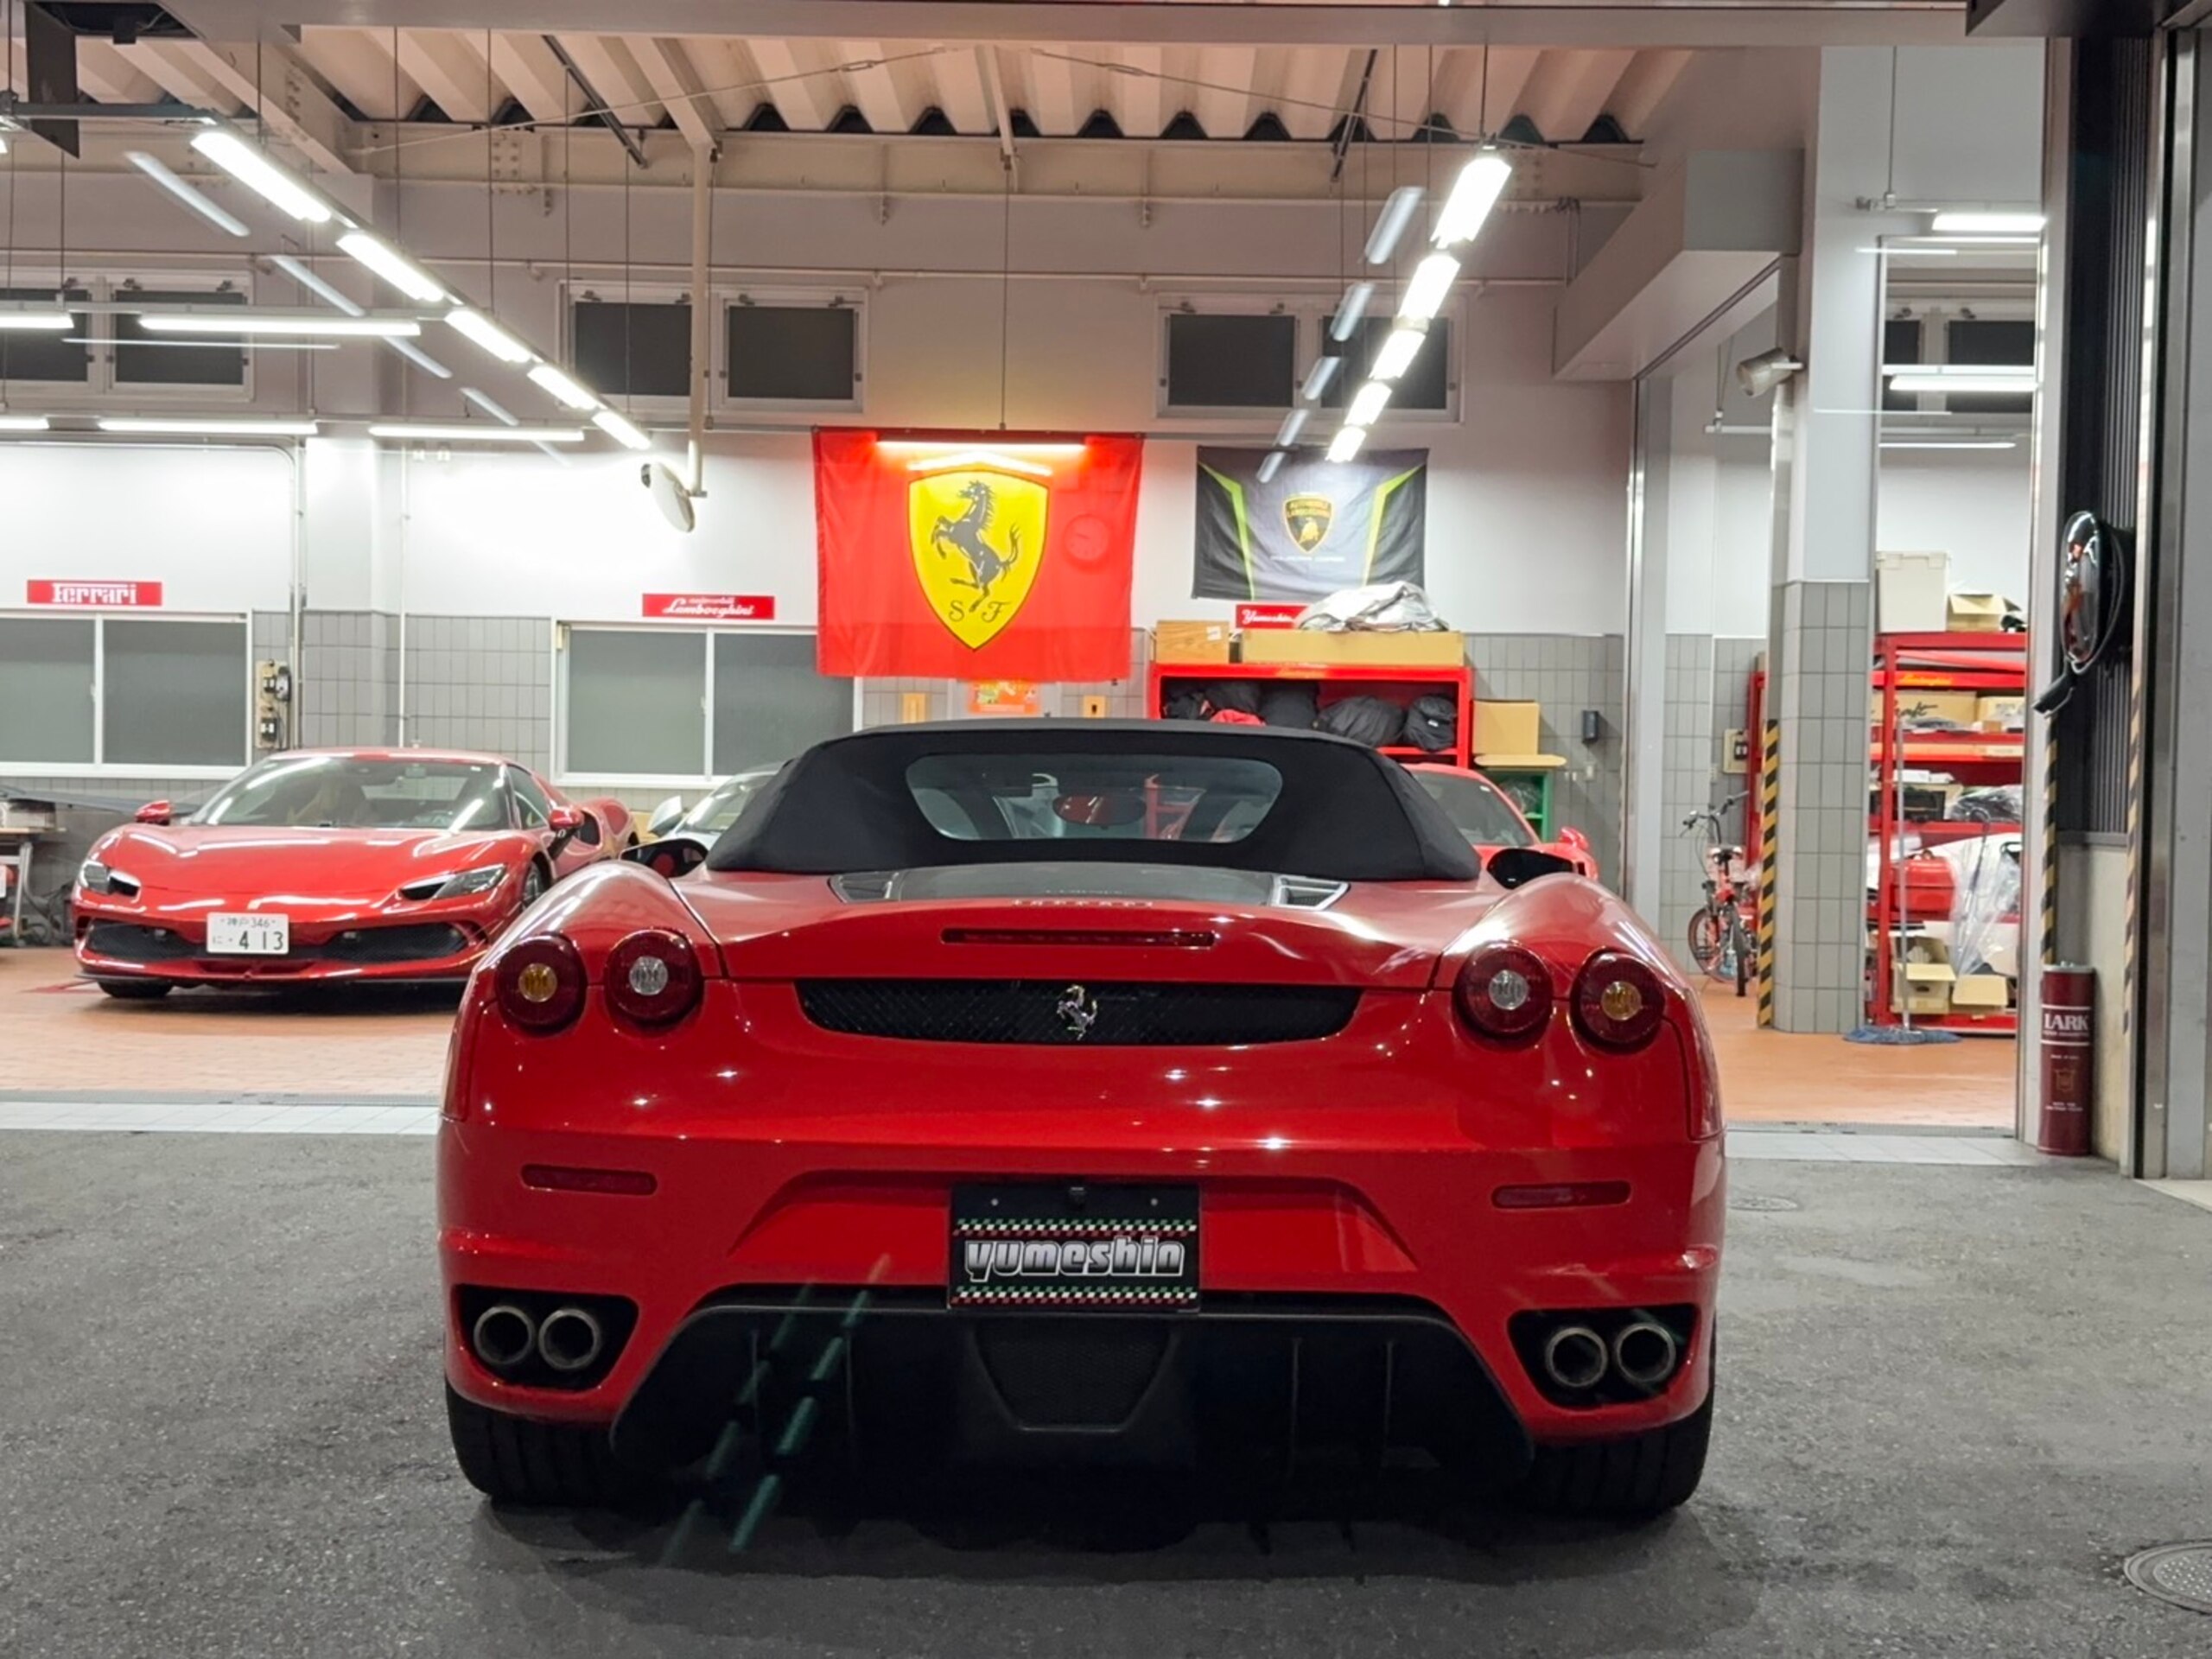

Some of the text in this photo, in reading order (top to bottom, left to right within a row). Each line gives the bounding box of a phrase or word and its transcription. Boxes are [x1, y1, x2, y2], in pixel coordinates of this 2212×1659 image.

[52, 583, 137, 604] Ferrari
[662, 597, 754, 618] Lamborghini
[949, 600, 1013, 623] S F
[2044, 1013, 2089, 1031] LARK
[965, 1235, 1185, 1282] yumeshin
